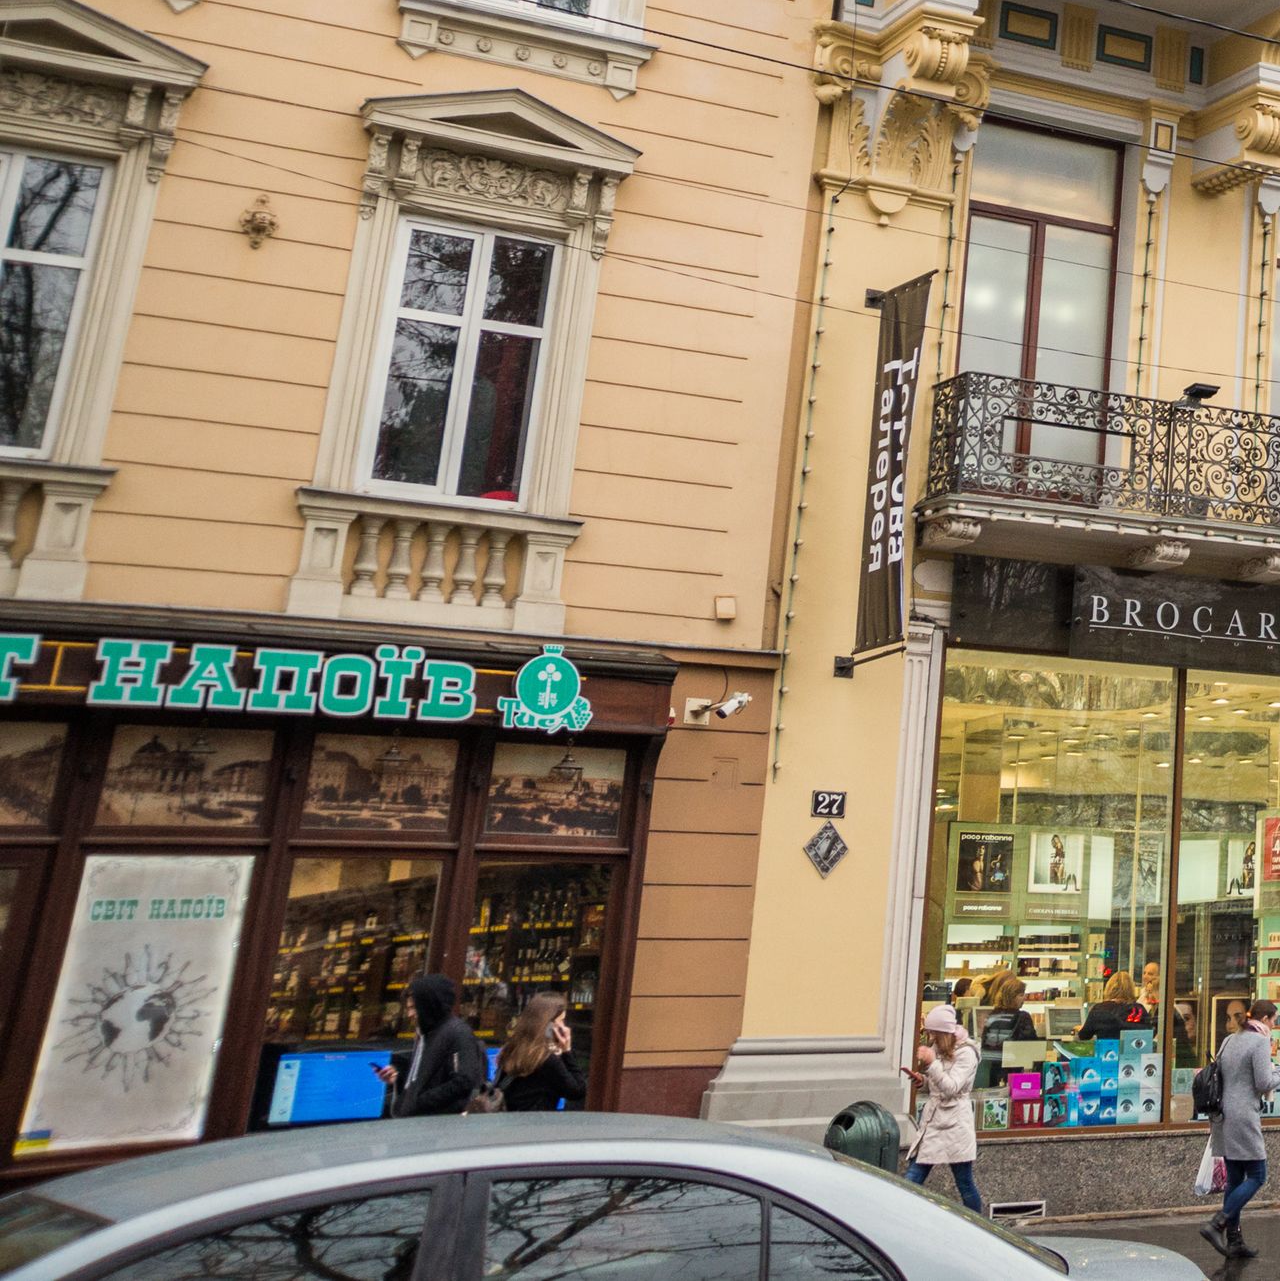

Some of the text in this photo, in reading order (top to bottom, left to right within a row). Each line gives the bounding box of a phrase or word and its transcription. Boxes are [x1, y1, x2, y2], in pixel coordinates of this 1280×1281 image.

[868, 359, 903, 573] Галерея
[87, 638, 477, 720] НАПОЇВ
[816, 792, 843, 815] 27
[961, 833, 981, 842] paco
[981, 834, 1013, 842] rabanne
[90, 895, 227, 921] СВІТ НАПОЇВ
